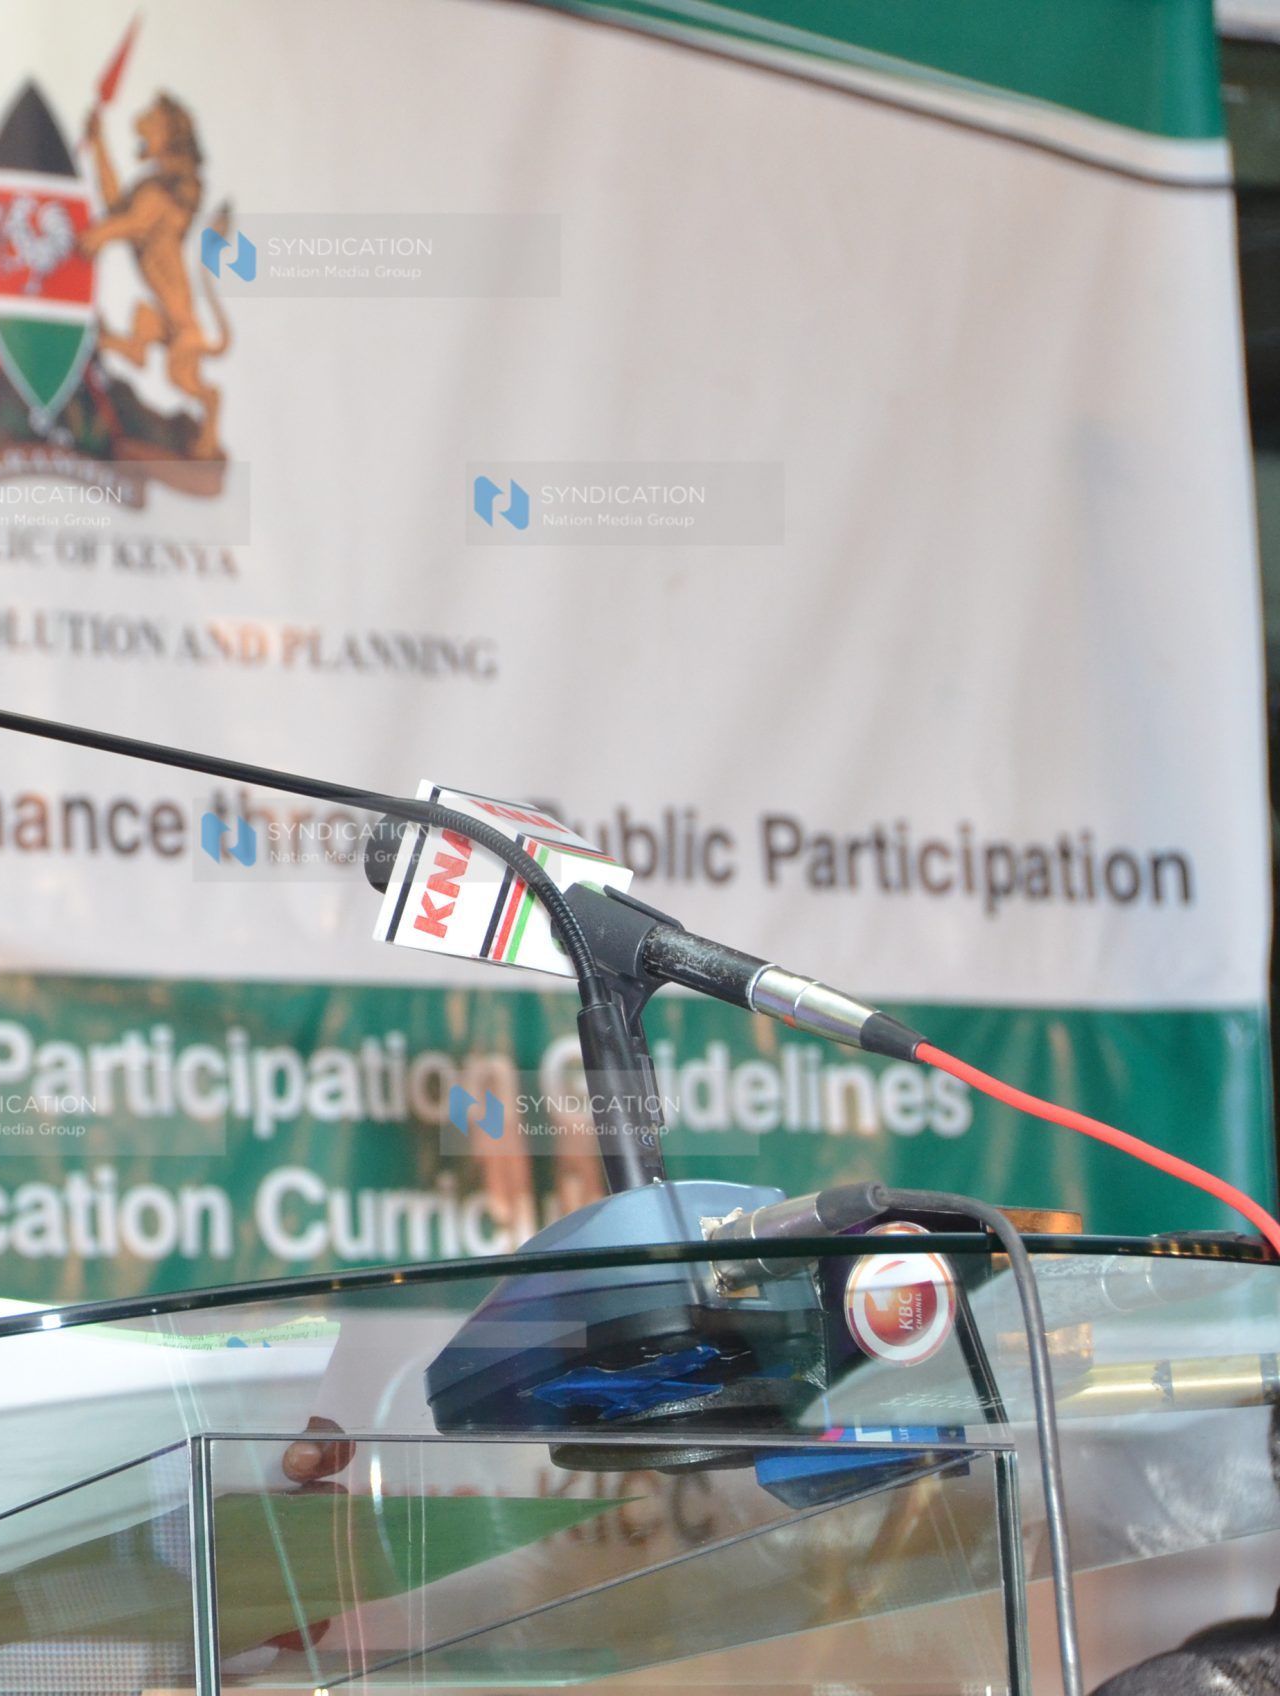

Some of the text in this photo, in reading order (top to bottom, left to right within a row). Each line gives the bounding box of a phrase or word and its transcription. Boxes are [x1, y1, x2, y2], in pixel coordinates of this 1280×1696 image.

[54, 528, 100, 567] OF
[111, 536, 241, 582] KENYA
[174, 616, 271, 668] AND
[276, 622, 498, 682] PLANNING
[528, 798, 736, 885] blic
[760, 811, 1197, 916] Participation
[539, 1033, 974, 1140] Gidelines
[898, 1292, 914, 1331] KBC
